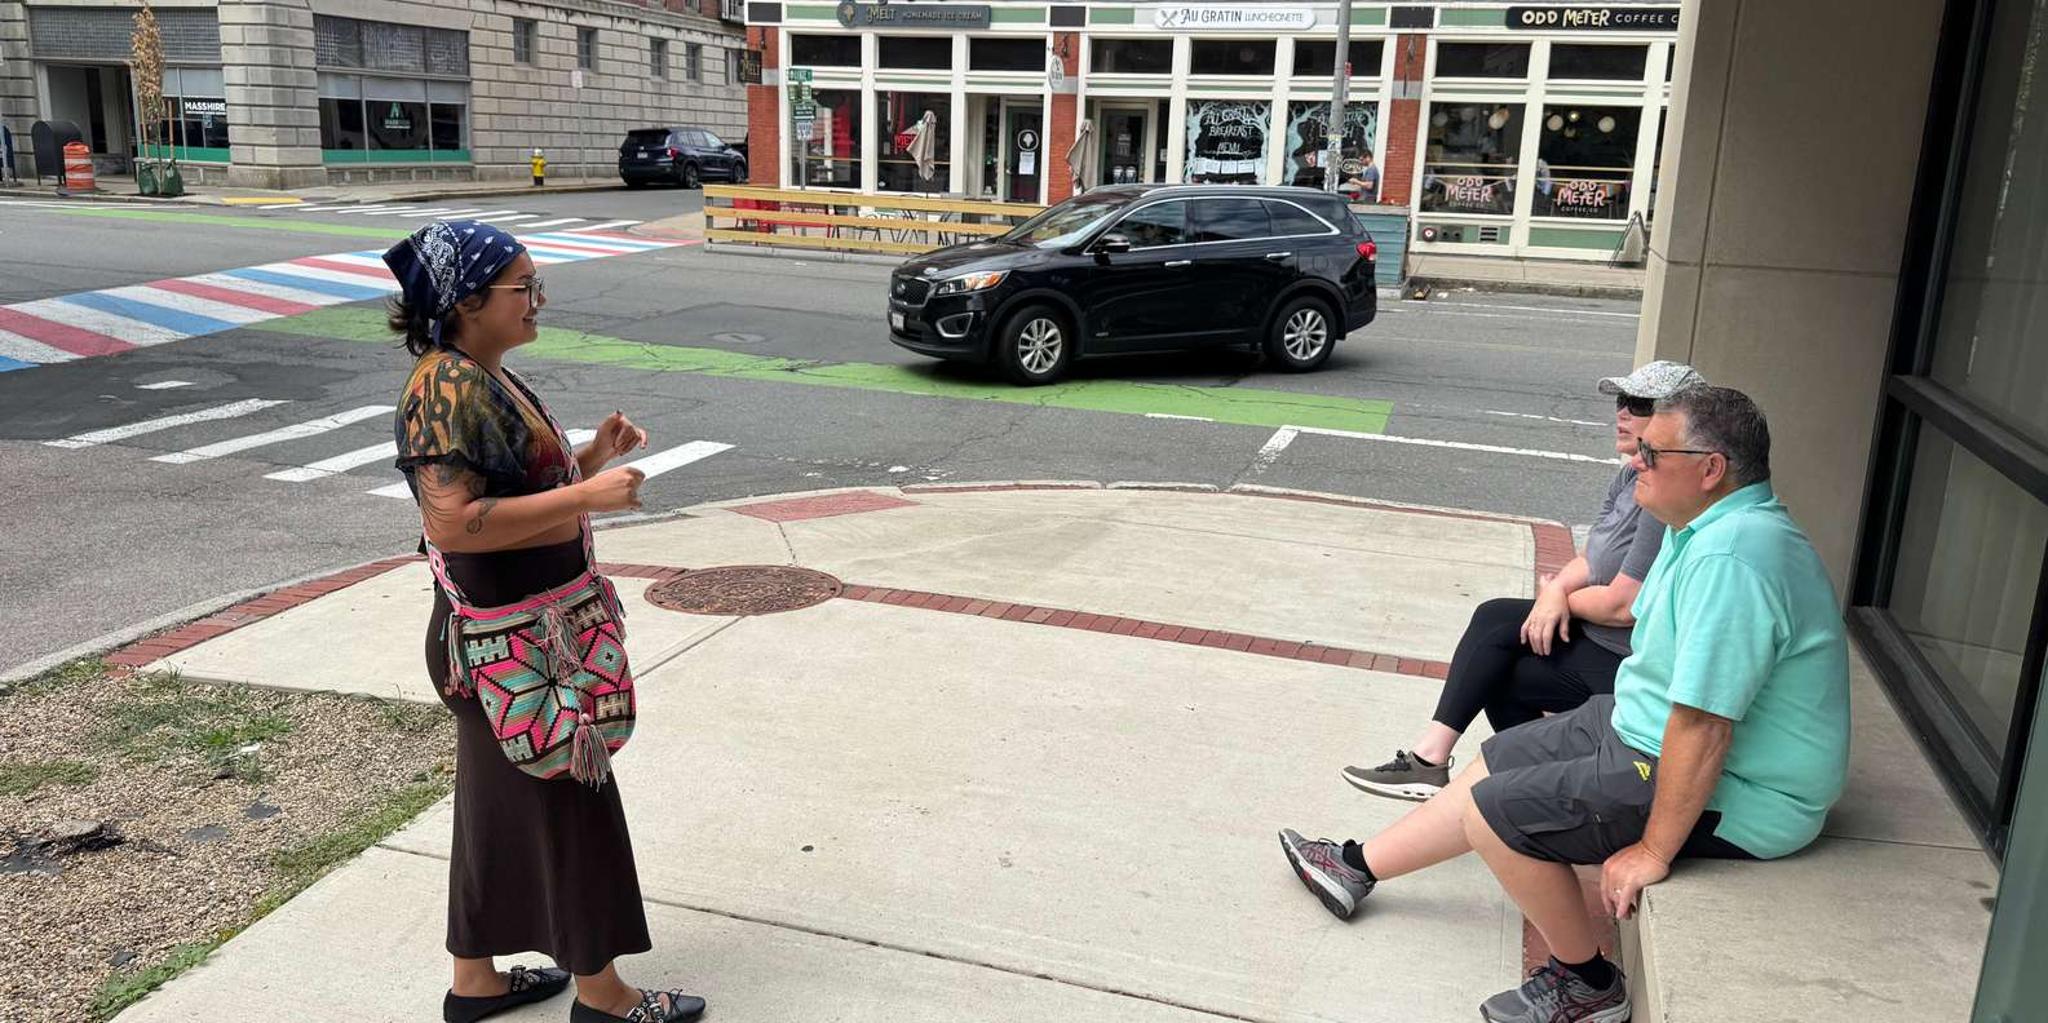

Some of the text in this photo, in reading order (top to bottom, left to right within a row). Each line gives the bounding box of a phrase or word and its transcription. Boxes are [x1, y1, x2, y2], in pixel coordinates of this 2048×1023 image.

[867, 6, 896, 23] MELT
[958, 11, 982, 21] CREAM
[1180, 9, 1303, 24] AU GRATIN LUNCHEONETTE
[1521, 9, 1679, 27] ODD METER COFFEE C
[184, 102, 226, 111] MASSHIRE
[1457, 176, 1484, 187] ODD
[1569, 181, 1597, 191] ODD
[1445, 185, 1491, 202] METER
[1557, 187, 1604, 207] METER
